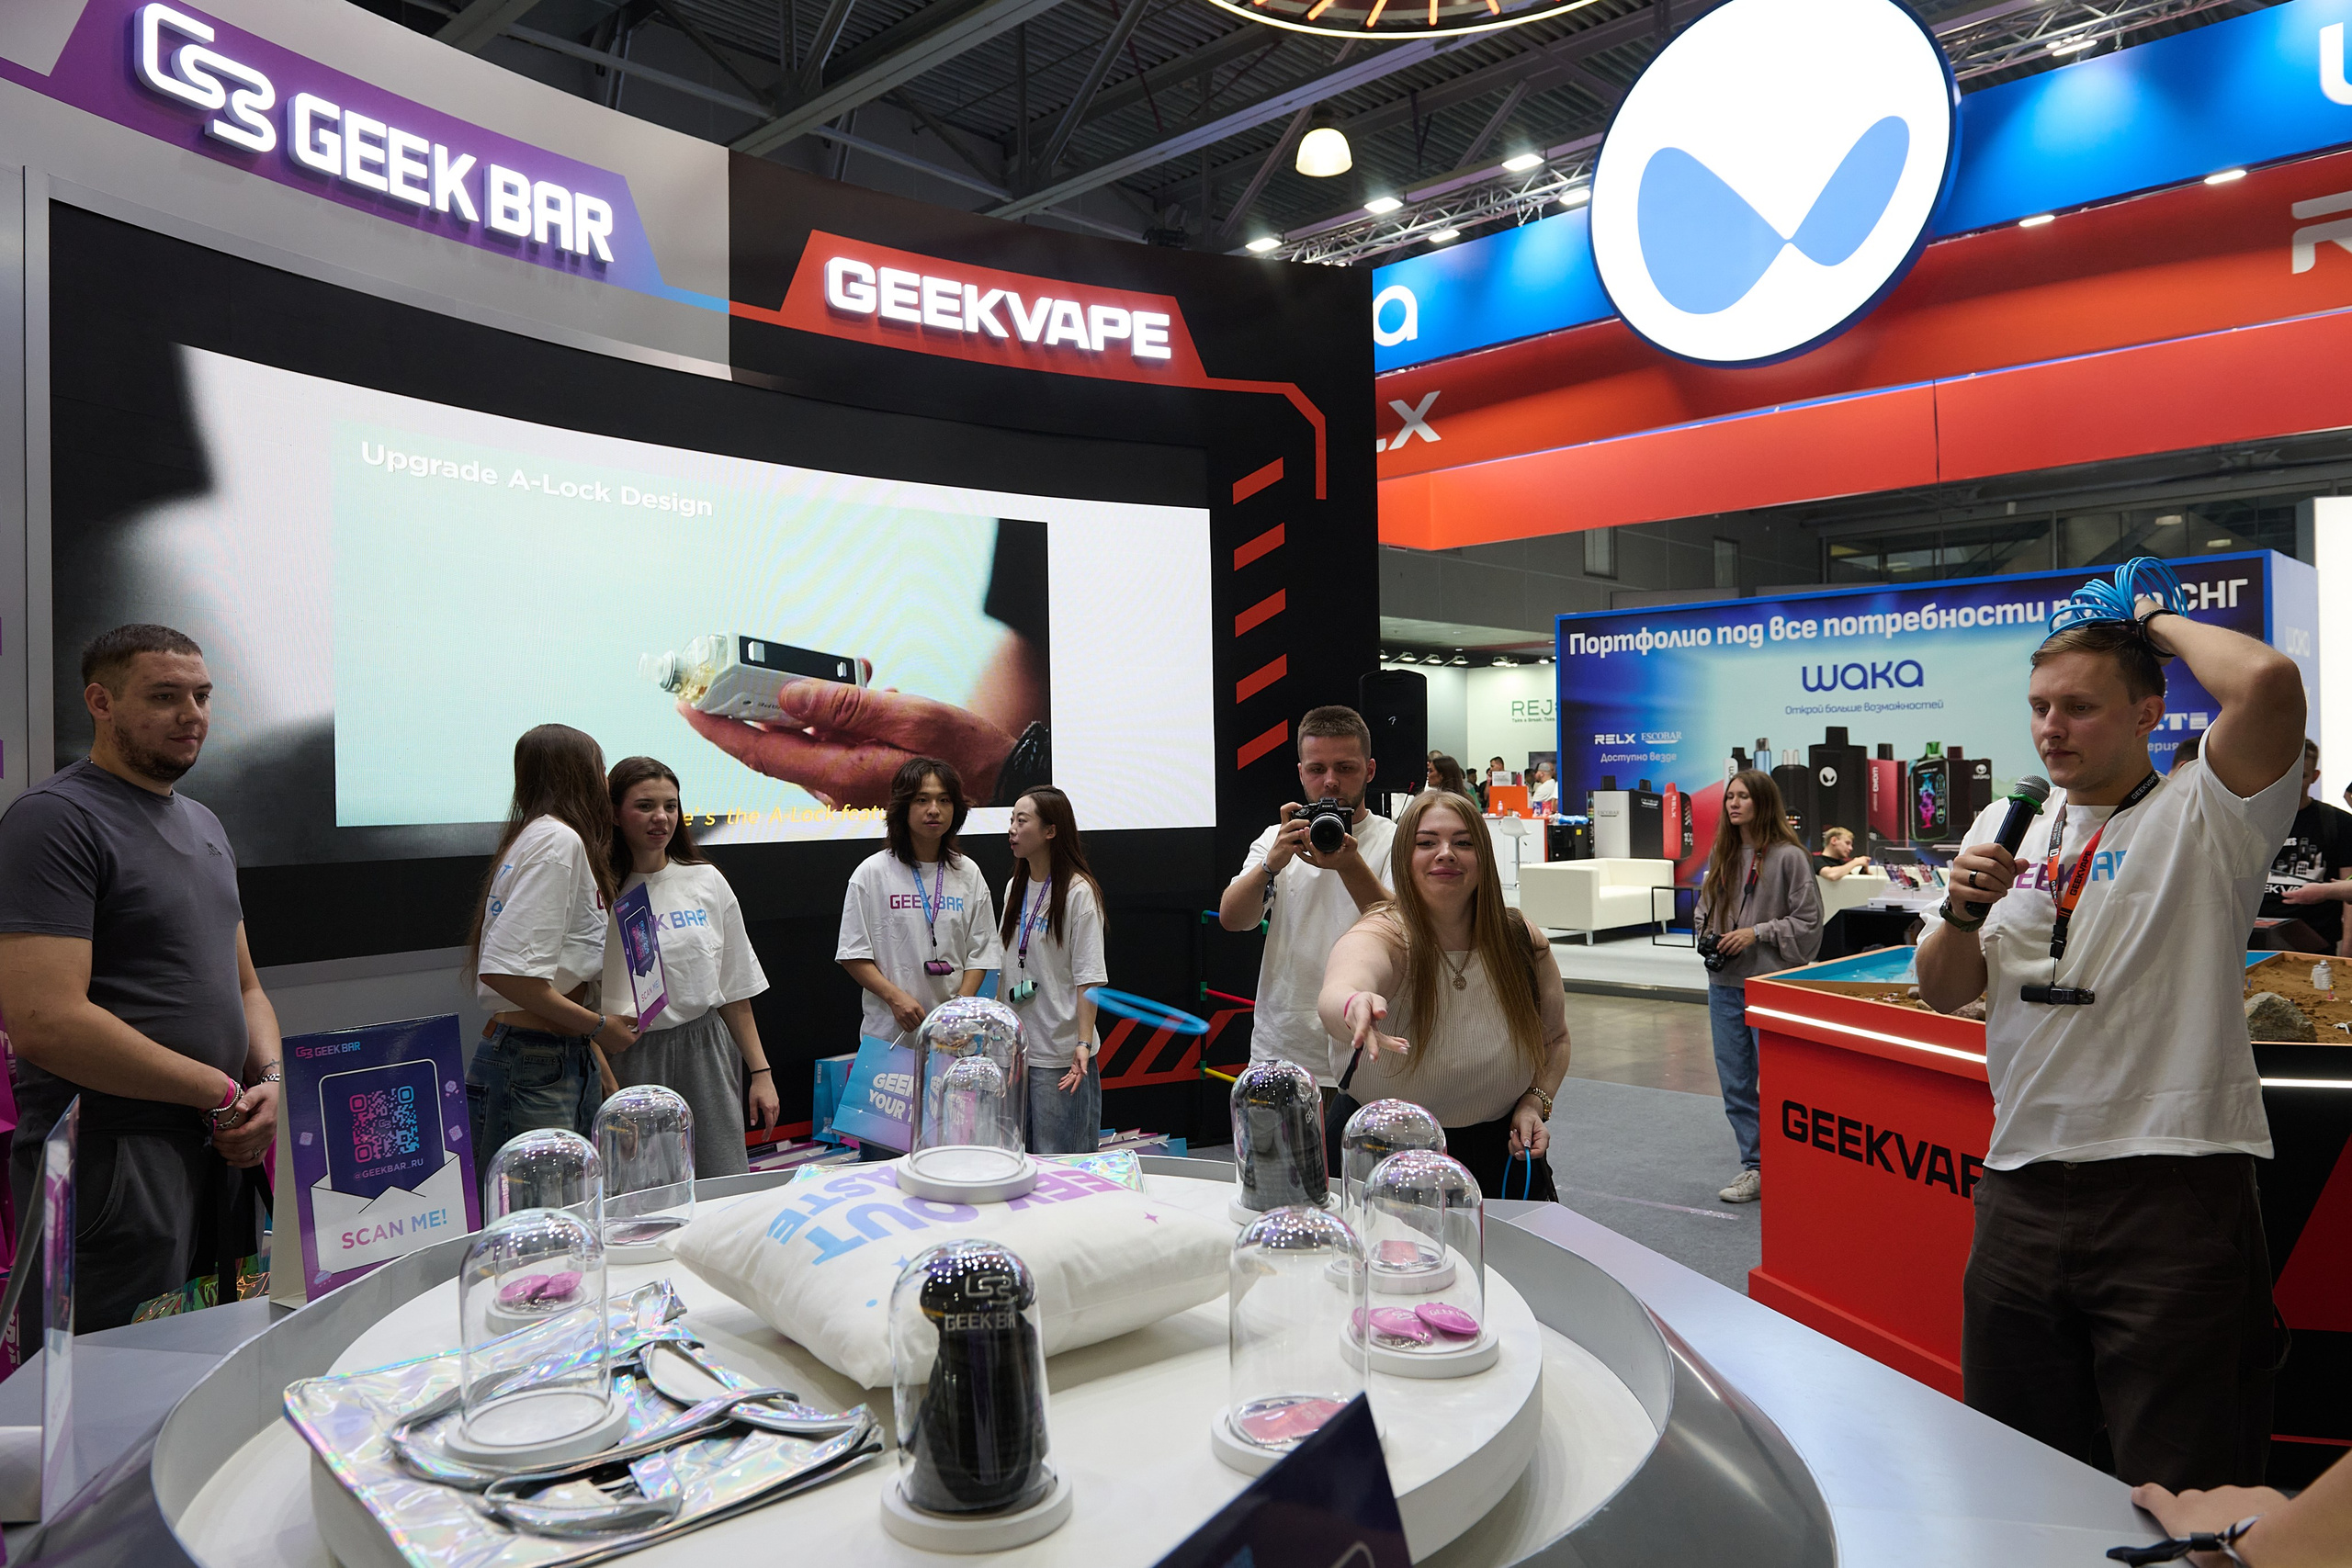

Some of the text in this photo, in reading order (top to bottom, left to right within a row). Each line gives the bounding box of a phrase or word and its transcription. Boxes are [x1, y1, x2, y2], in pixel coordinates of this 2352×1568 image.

[288, 91, 479, 222] GEEK
[484, 162, 615, 264] BAR
[825, 256, 1172, 360] GEEKVAPE
[361, 441, 713, 518] Upgrade A-Lock Design
[1569, 626, 1712, 659] Портфолио
[1716, 623, 1764, 649] под
[1770, 615, 1817, 641] все
[1823, 601, 2045, 639] потребности
[2173, 579, 2248, 611] СНГ
[1512, 699, 1556, 716] REJ
[1785, 700, 1943, 716] Открой больше возможностей
[1594, 731, 1682, 745] RELX ESCOBAR
[1600, 751, 1677, 763] Доступно везде
[2132, 773, 2157, 799] GEEKVAPE
[726, 807, 760, 825] the
[768, 804, 837, 824] A-Lock
[2012, 863, 2084, 891] EEK
[2069, 851, 2092, 896] GEEKVAPE
[670, 908, 708, 929] BAR
[315, 1042, 361, 1056] GEEK BAR
[869, 1089, 907, 1121] YOUR
[1782, 1100, 1984, 1200] GEEKVAP
[353, 1158, 424, 1180] @GEEKBAR_RU
[765, 1165, 899, 1246] ASTE
[341, 1208, 448, 1250] SCAN ME!
[944, 1313, 992, 1332] GEEK
